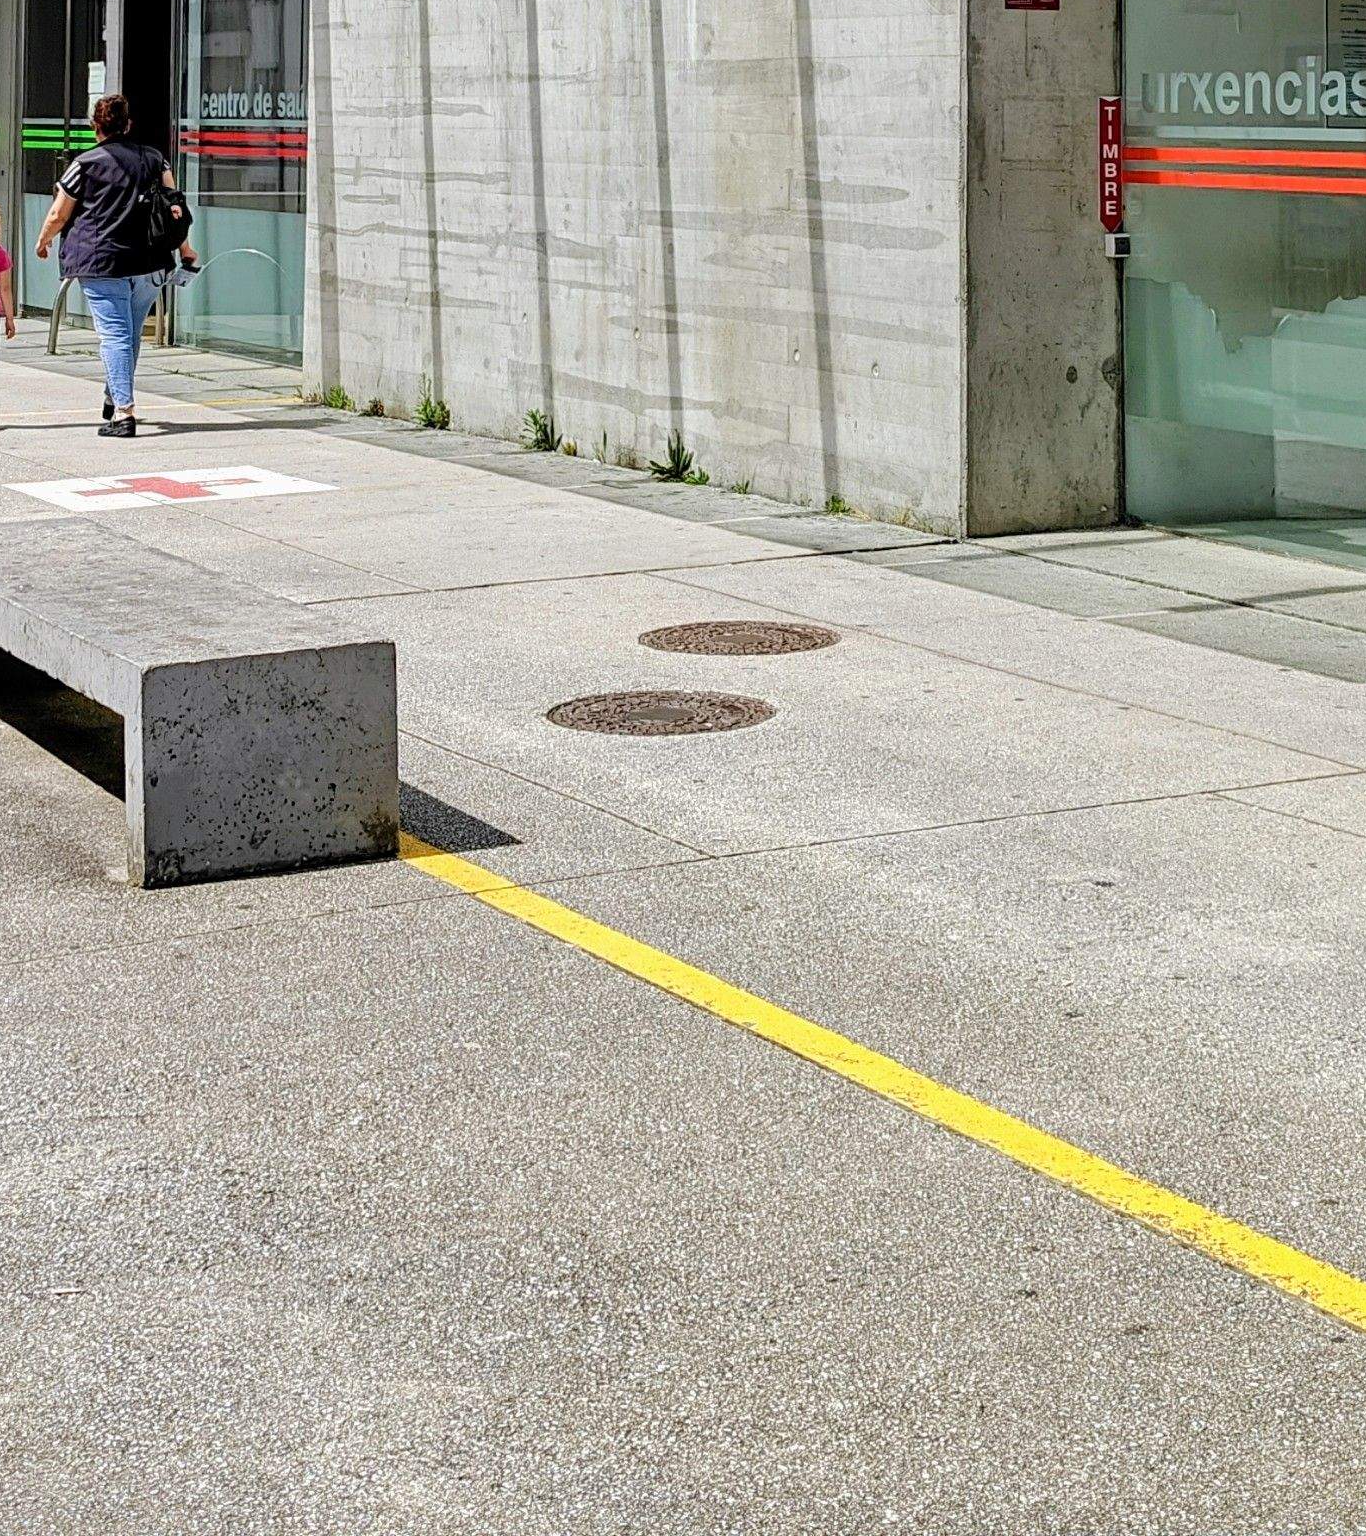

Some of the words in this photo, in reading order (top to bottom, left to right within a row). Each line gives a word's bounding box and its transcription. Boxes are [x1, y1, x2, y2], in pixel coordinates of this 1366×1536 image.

[201, 84, 248, 117] centro
[253, 83, 272, 117] de
[277, 85, 308, 117] saú
[1102, 106, 1119, 216] TIMBRE
